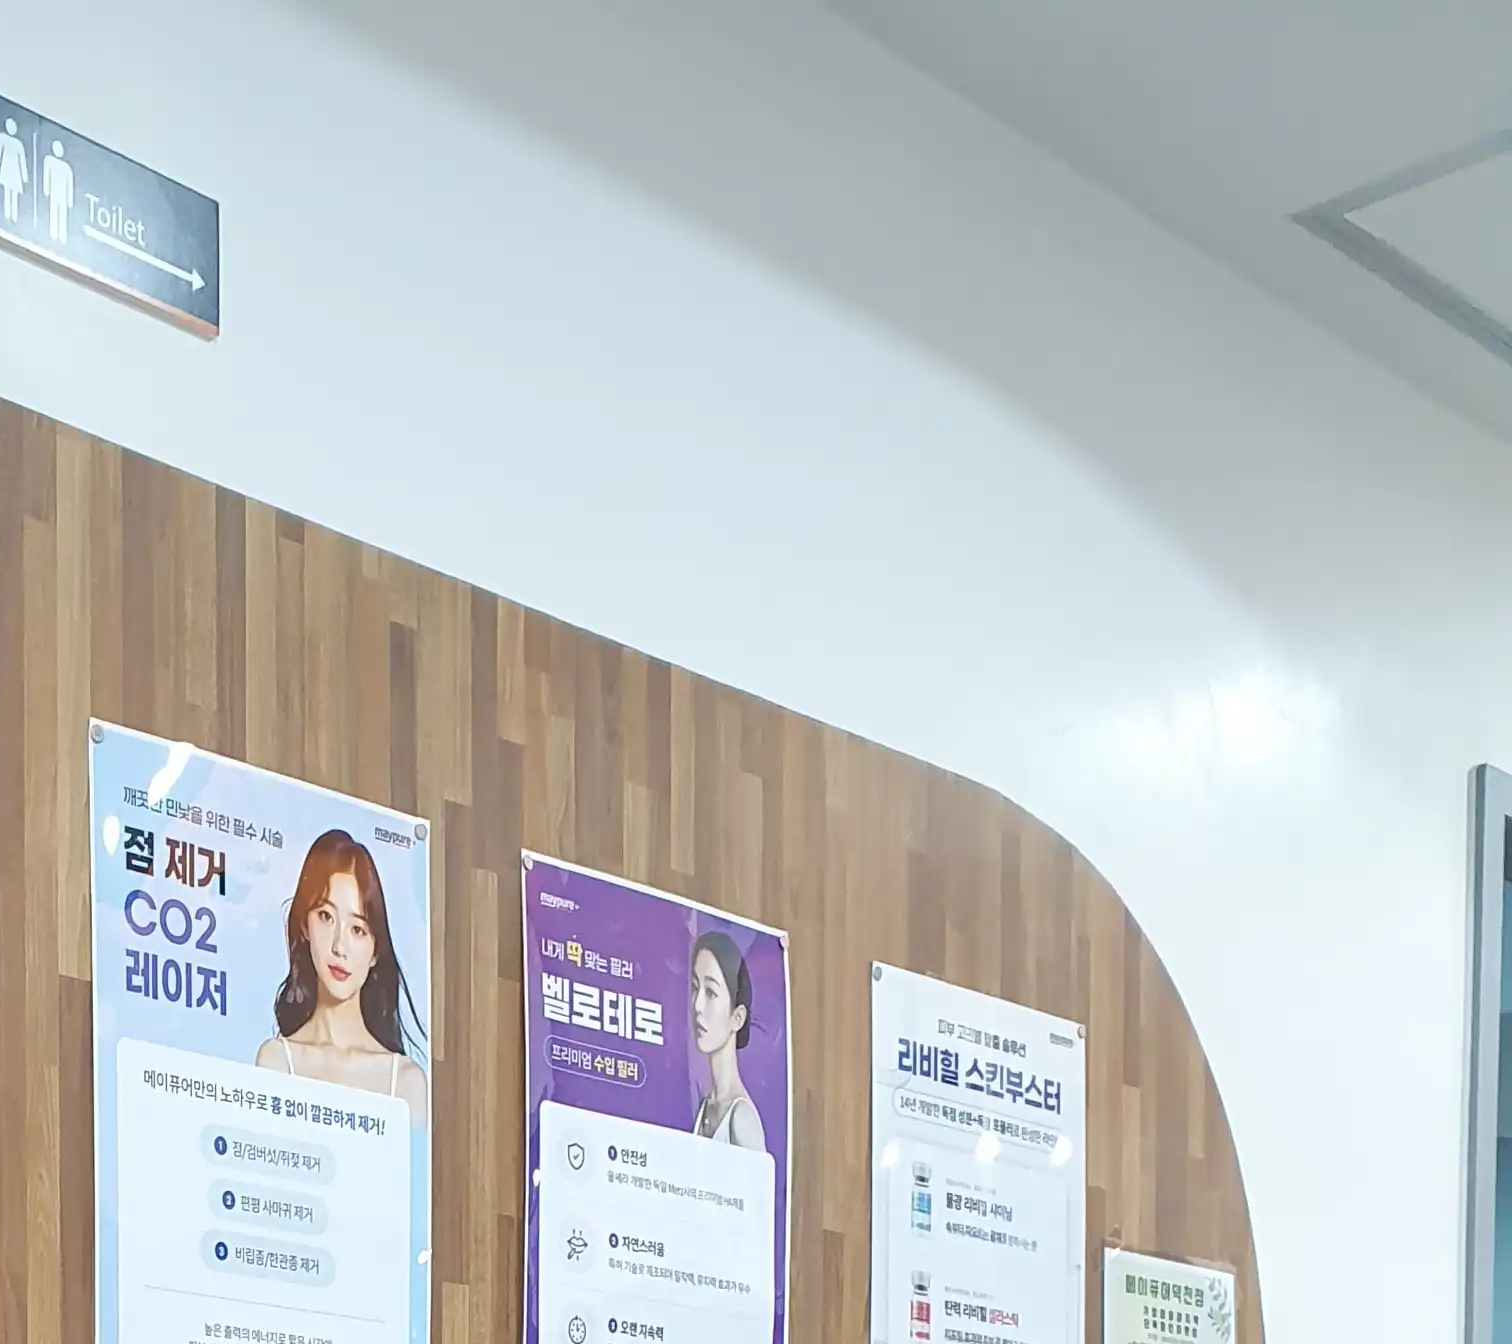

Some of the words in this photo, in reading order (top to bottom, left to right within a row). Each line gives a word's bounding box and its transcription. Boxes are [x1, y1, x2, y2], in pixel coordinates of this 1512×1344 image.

[84, 192, 148, 249] Toilet
[165, 797, 202, 826] 민낯을
[205, 809, 229, 834] 위한
[232, 817, 256, 842] 필수
[260, 825, 283, 850] 시술
[374, 825, 412, 850] maypure
[123, 823, 154, 877] 점
[164, 835, 226, 897] 제거
[123, 885, 217, 955] CO2
[125, 946, 226, 1017] 레이저
[541, 937, 564, 961] 내게
[565, 938, 583, 968] 딱
[584, 949, 607, 974] 맞는
[609, 955, 634, 981] 필러
[541, 971, 664, 1048] 벨로테로
[551, 1042, 592, 1071] 프리미엄
[593, 1052, 615, 1076] 수입
[616, 1057, 638, 1082] 필러
[898, 1036, 959, 1087] 리비힐
[965, 1055, 1061, 1114] 스킨부스터
[143, 1067, 217, 1102] 메이퓨어만의
[220, 1084, 267, 1111] 노하우로
[270, 1094, 283, 1116] 흉
[284, 1097, 307, 1121] 없이
[309, 1103, 355, 1131] 깔끔하게
[357, 1113, 385, 1137] 제거!
[232, 1139, 300, 1170] 점/검버섯/쥐젖
[302, 1154, 320, 1172] 제거
[240, 1194, 260, 1214] 편평
[262, 1198, 292, 1220] 사마귀
[293, 1204, 313, 1223] 제거
[299, 1256, 319, 1275] 제거
[621, 1234, 665, 1258] 자연스러움
[620, 1319, 637, 1337] 오랜
[638, 1323, 663, 1342] 지속력
